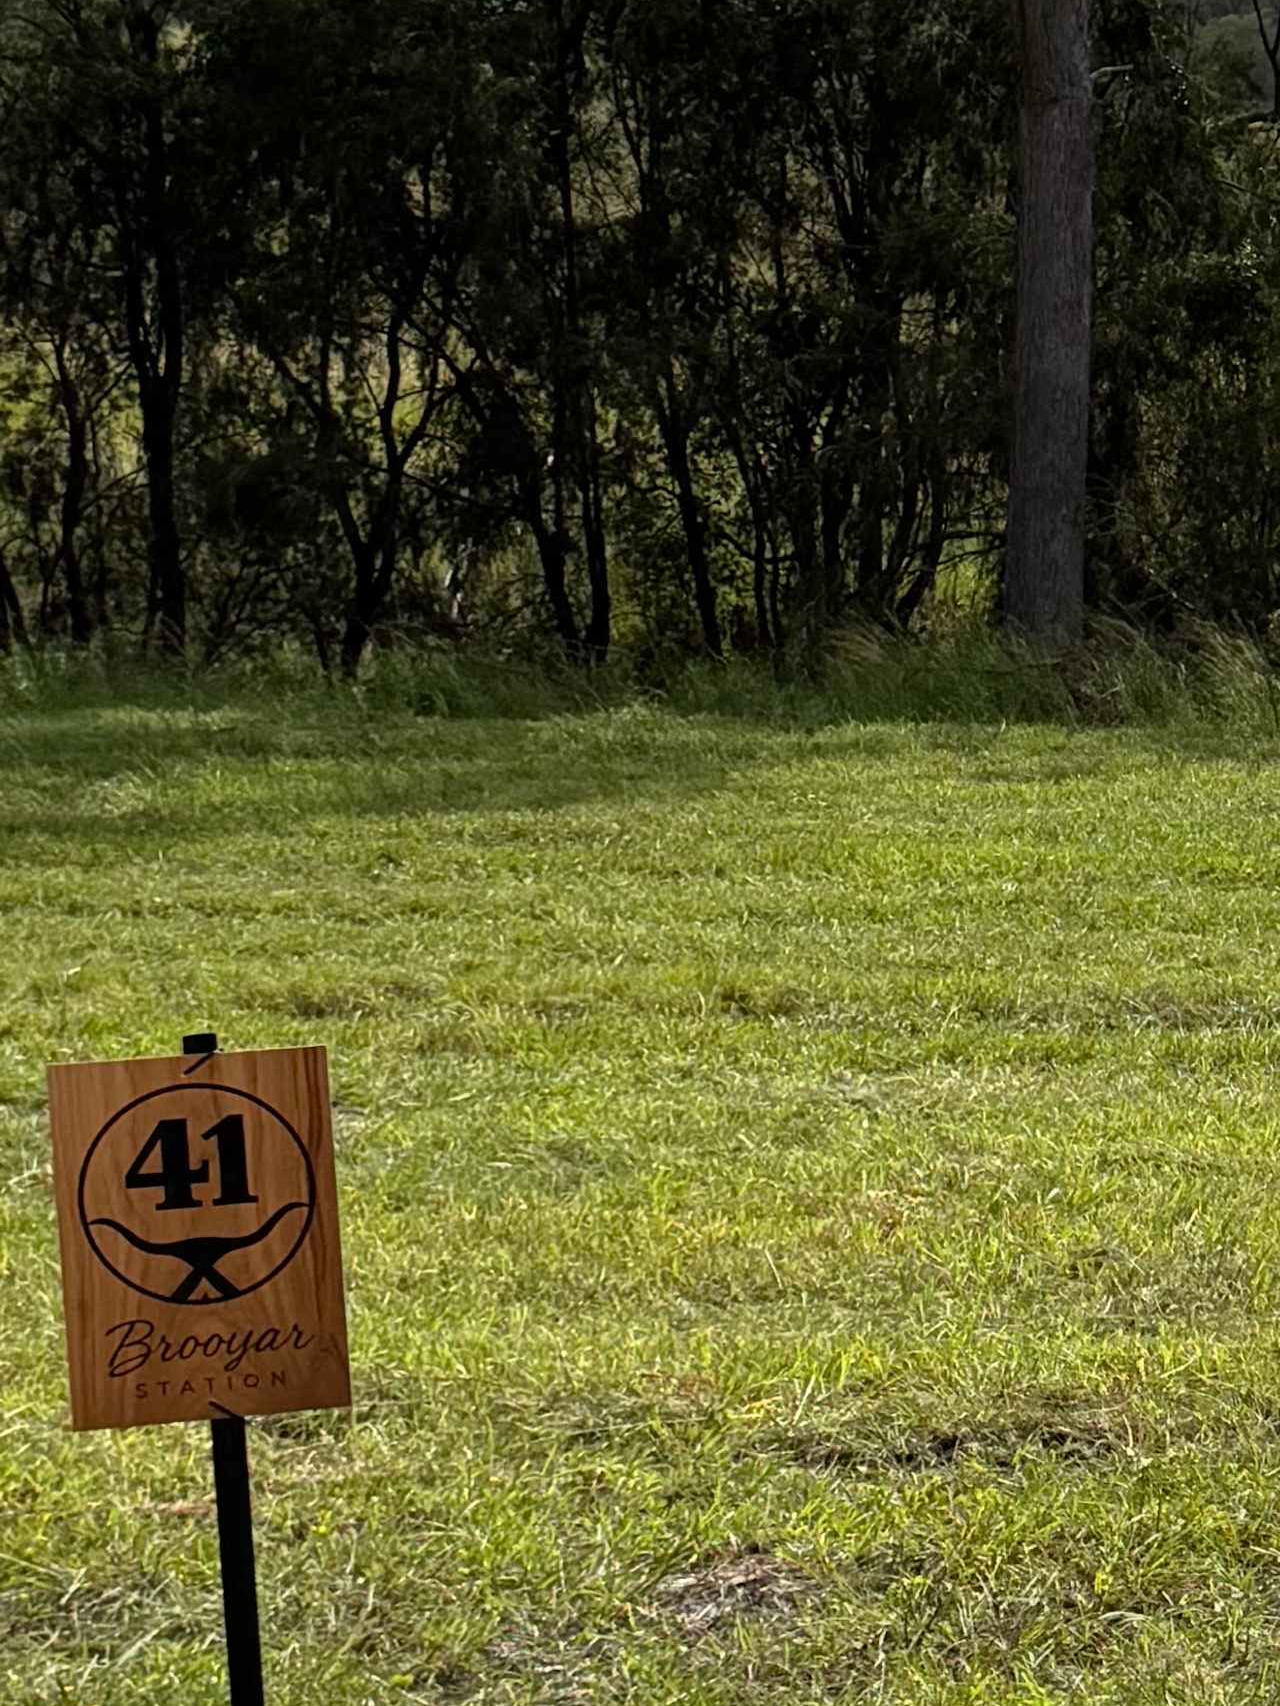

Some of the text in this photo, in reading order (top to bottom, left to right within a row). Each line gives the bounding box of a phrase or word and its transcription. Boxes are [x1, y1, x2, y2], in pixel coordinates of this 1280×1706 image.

[125, 1113, 259, 1211] 41
[105, 1319, 315, 1378] Brooyar
[135, 1370, 288, 1399] STATION
